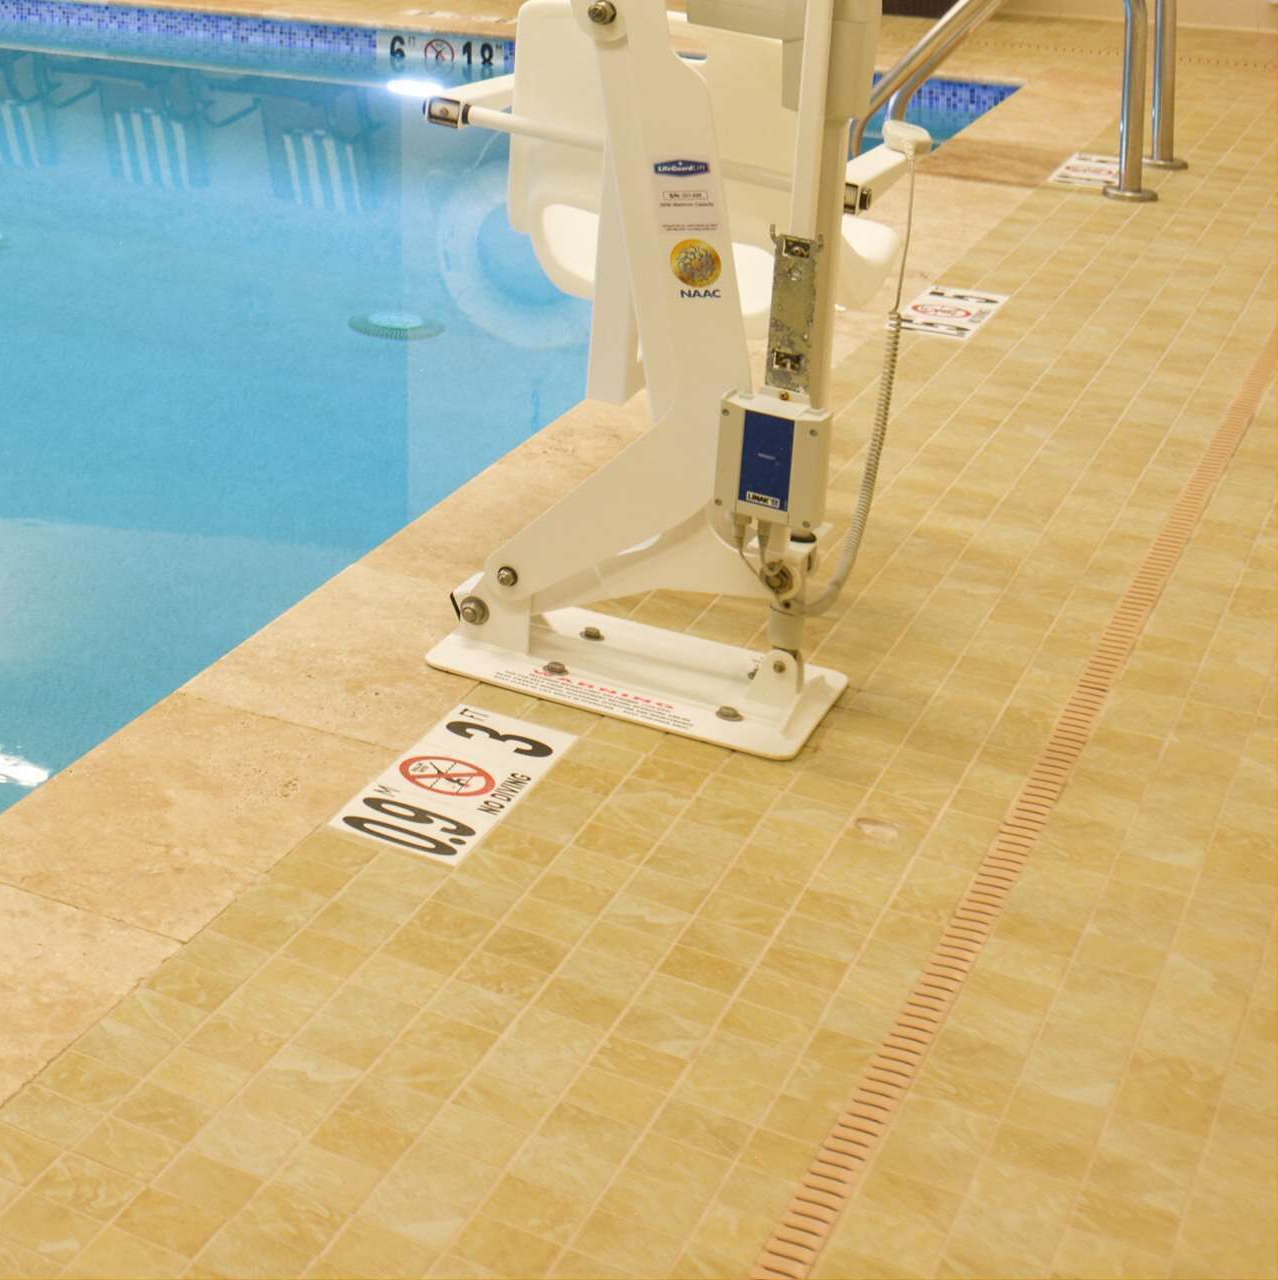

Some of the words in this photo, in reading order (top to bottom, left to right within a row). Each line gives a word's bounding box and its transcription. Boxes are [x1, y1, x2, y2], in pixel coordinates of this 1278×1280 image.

[680, 288, 721, 298] NAAC
[445, 720, 554, 759] 3
[477, 800, 505, 816] NO
[491, 772, 532, 803] DIVING
[342, 796, 476, 856] 0.9
